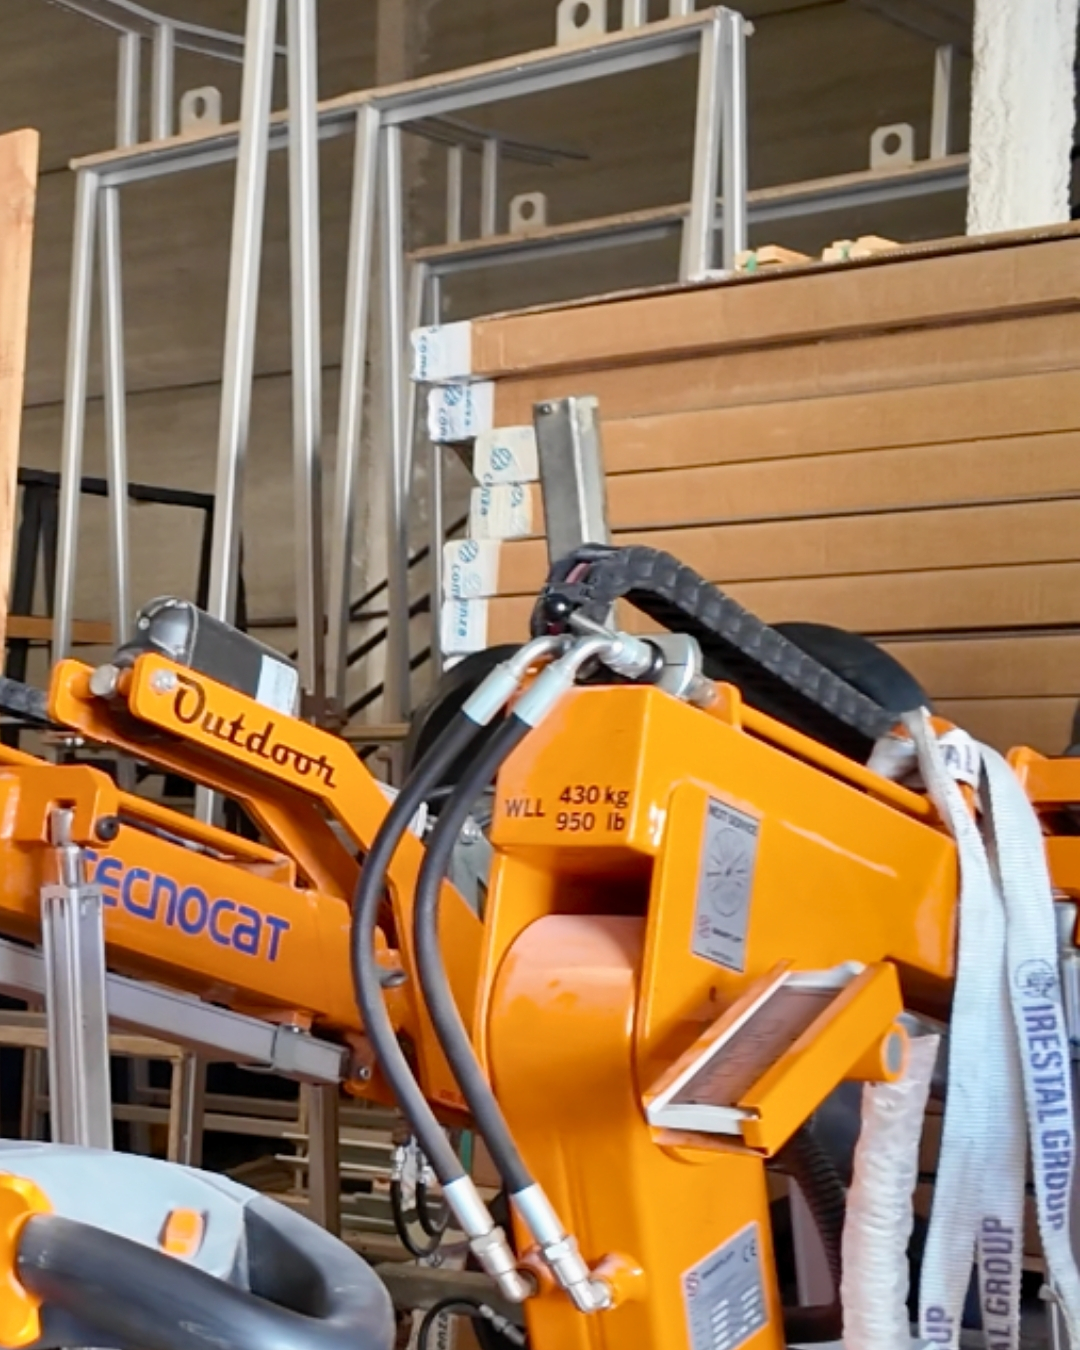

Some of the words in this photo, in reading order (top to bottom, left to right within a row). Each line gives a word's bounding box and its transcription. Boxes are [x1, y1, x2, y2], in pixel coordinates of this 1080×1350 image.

[173, 672, 337, 789] Outdoor
[505, 798, 546, 818] WLL
[555, 811, 596, 832] 950
[606, 812, 626, 832] lb
[559, 784, 601, 805] 430
[604, 785, 630, 810] kg
[1040, 1128, 1071, 1232] GROUP
[981, 1215, 1014, 1317] GROUP
